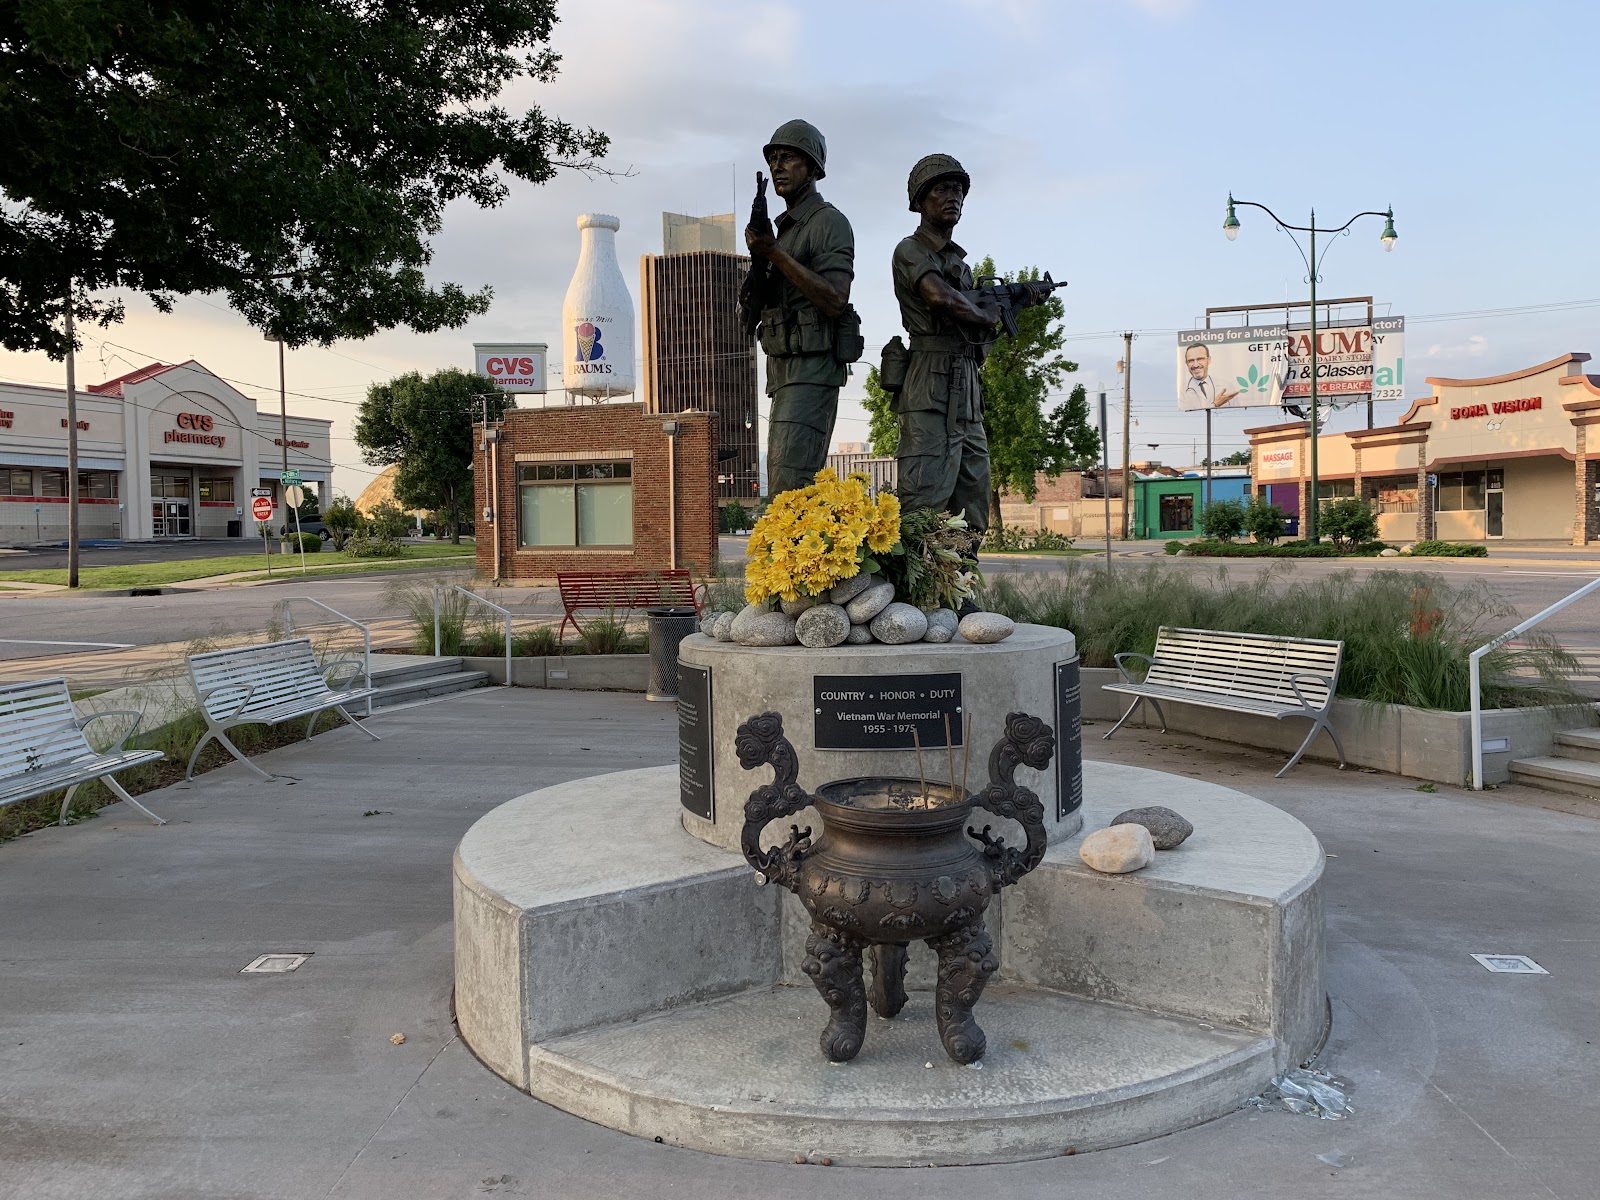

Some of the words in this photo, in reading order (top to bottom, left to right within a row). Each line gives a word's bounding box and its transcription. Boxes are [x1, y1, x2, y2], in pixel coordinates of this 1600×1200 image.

[1181, 330, 1224, 343] Looking
[1226, 330, 1243, 339] for
[1372, 319, 1403, 330] ctor?
[1248, 343, 1271, 352] GET
[486, 357, 534, 375] CVS
[1300, 365, 1312, 379] &
[1316, 364, 1374, 378] Classen
[1289, 383, 1328, 393] SERVNG
[1491, 397, 1542, 415] VISION
[177, 412, 214, 431] CVS
[164, 428, 226, 448] pharmacy
[1263, 451, 1293, 462] MASSAGE
[820, 691, 865, 701] COUNTRY
[880, 691, 916, 700] HONOR
[930, 689, 955, 699] DUTY
[837, 711, 876, 721] Vietnam
[877, 711, 896, 721] War
[897, 710, 940, 720] Memorial
[863, 725, 886, 733] 1955
[893, 724, 916, 733] 1975
